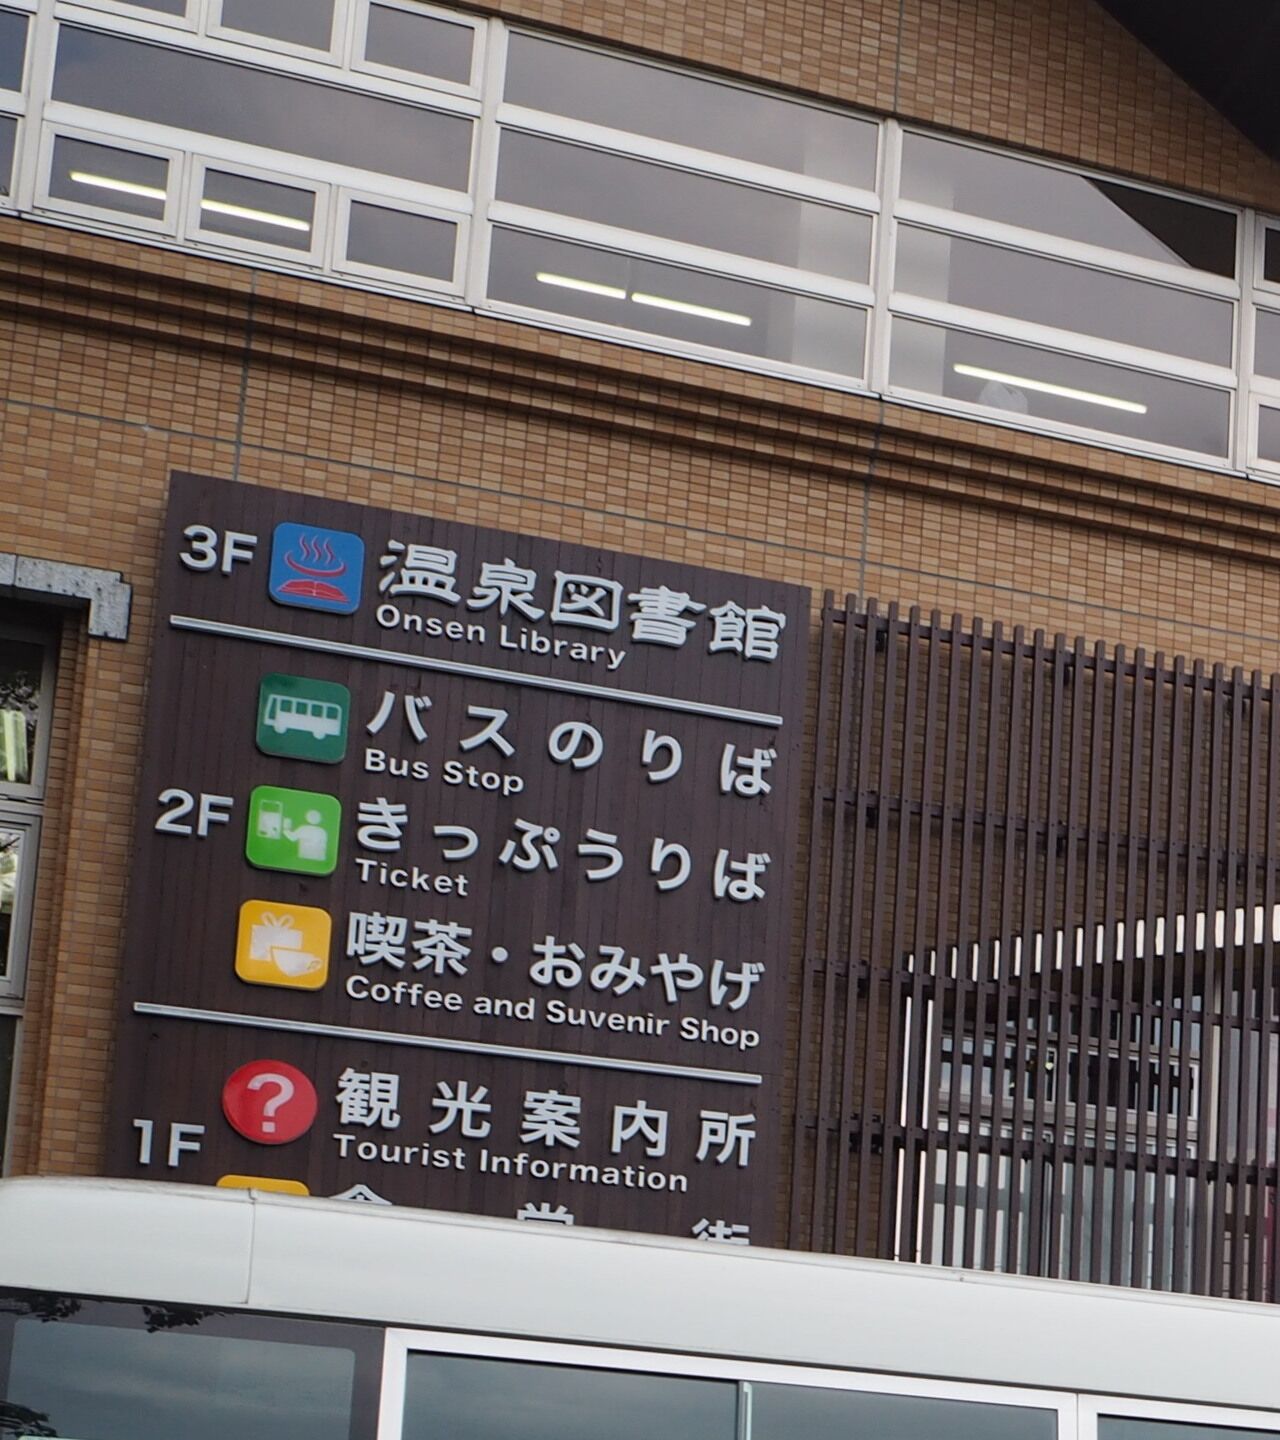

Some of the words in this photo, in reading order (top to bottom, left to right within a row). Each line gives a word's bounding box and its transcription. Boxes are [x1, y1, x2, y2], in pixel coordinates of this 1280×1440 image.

[179, 524, 258, 575] 3F
[378, 539, 786, 662] 温泉図書館
[375, 603, 486, 644] Onsen
[500, 623, 627, 671] Library
[364, 747, 430, 780] Bus
[443, 760, 525, 797] Stop
[366, 691, 778, 798] バスのりば
[154, 787, 234, 839] 2F
[355, 857, 470, 898] Ticket
[356, 796, 771, 901] きっぷうりば
[346, 910, 766, 1012] 喫茶・おみやげ
[345, 974, 464, 1013] Coffee
[473, 993, 536, 1022] and
[546, 1000, 671, 1038] Suvenir
[680, 1016, 761, 1051] Shop
[132, 1118, 206, 1168] 1F
[336, 1066, 757, 1168] 観光案内所
[333, 1133, 467, 1171] Tourist
[479, 1148, 689, 1193] Information
